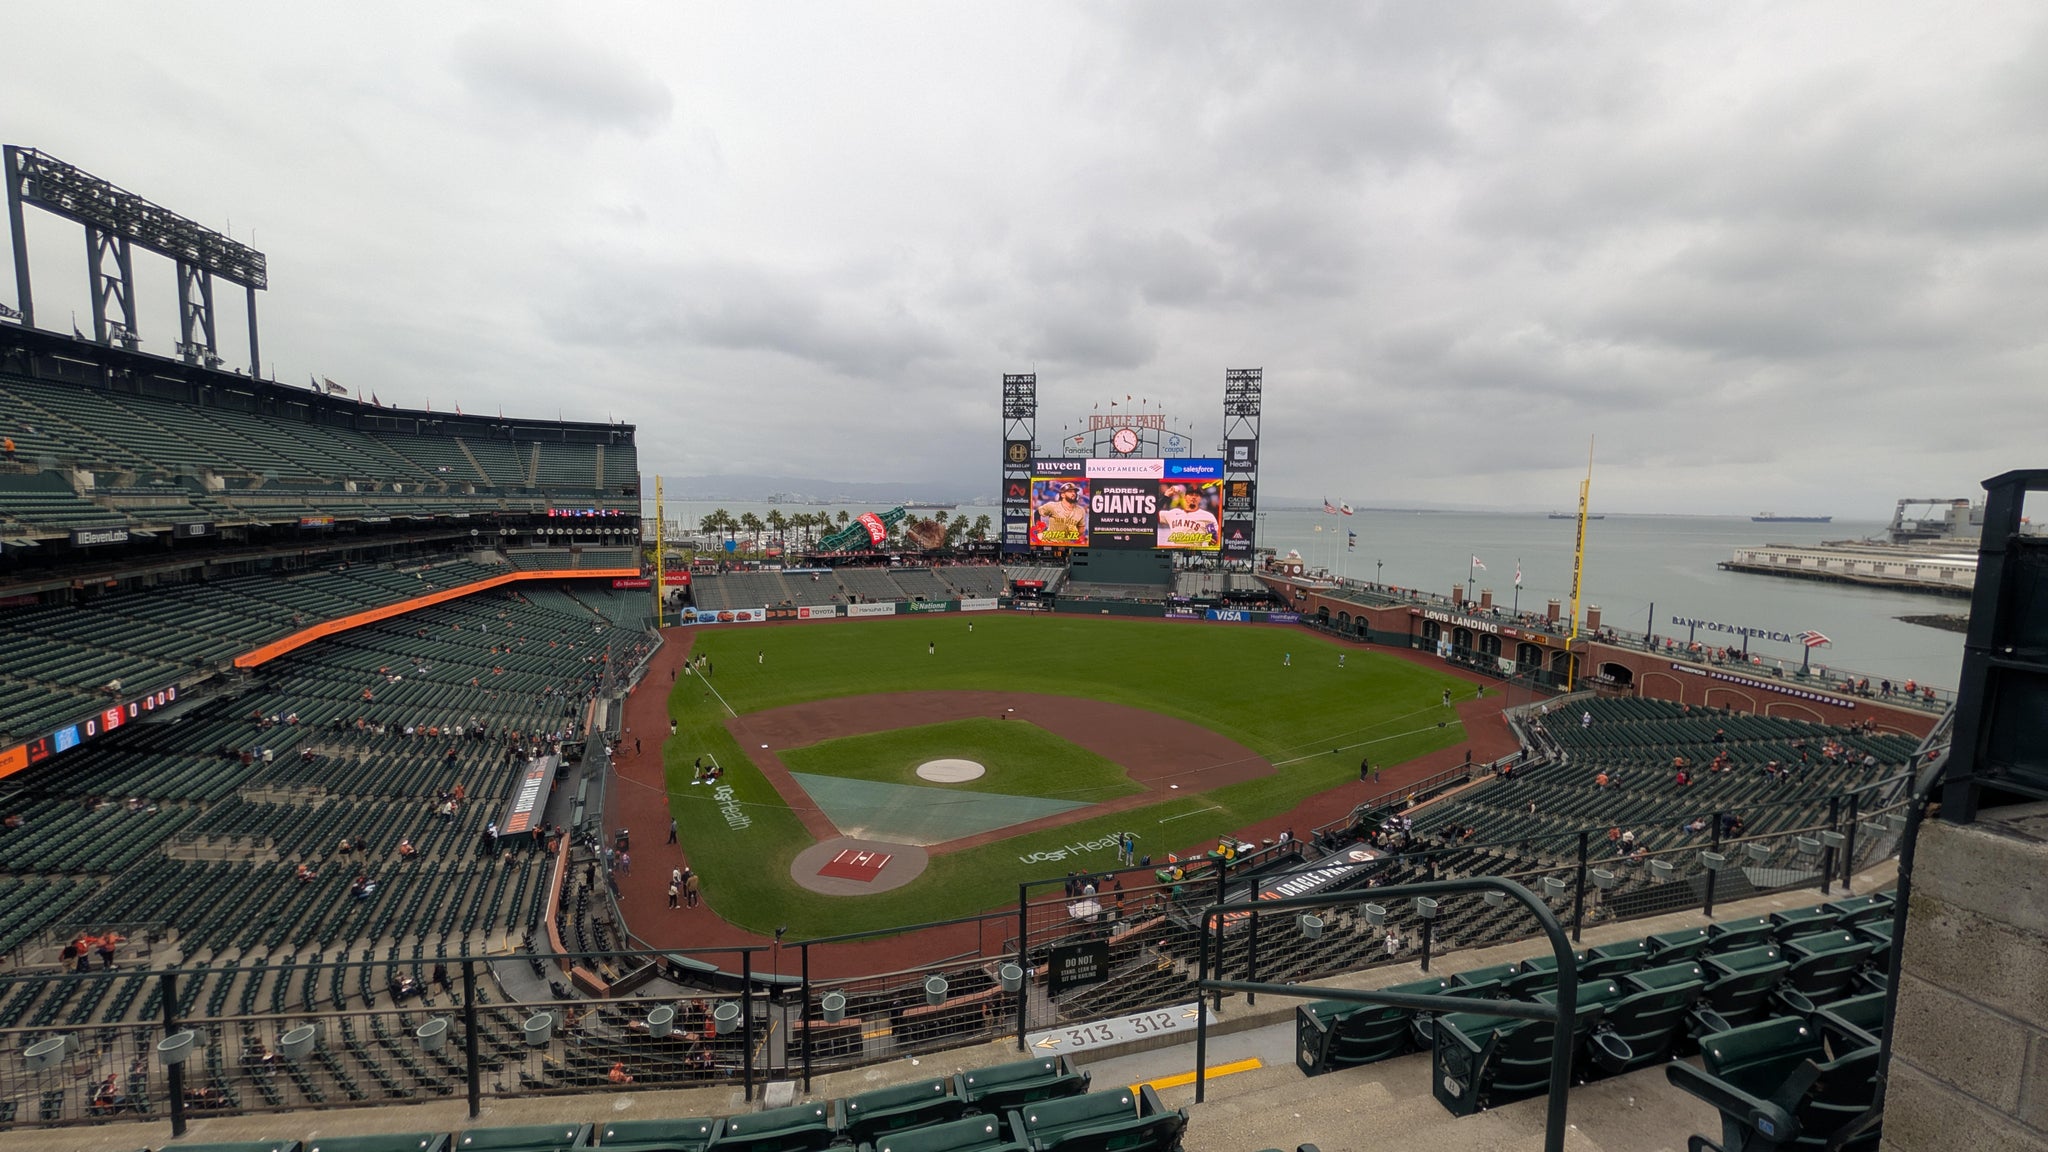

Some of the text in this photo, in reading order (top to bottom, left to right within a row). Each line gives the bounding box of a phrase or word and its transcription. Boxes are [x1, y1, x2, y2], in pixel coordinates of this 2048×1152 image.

[1089, 414, 1166, 430] ORACLE PARK
[1036, 462, 1081, 470] nuveen
[1092, 495, 1156, 514] GIANTS
[1172, 520, 1200, 531] GIANTS
[1215, 610, 1241, 621] VISA
[1451, 617, 1498, 634] LANDING
[1672, 616, 1792, 643] BANK OF AMERICA
[86, 720, 95, 736] 0
[130, 703, 137, 717] 0
[148, 696, 154, 710] 0
[159, 692, 165, 705] 0
[169, 688, 175, 700] 0
[1019, 850, 1068, 864] UCSF
[1276, 871, 1326, 897] ORACLE
[1066, 955, 1093, 968] DO NOT
[1066, 1013, 1176, 1047] 313 312
[1449, 1080, 1454, 1091] B
